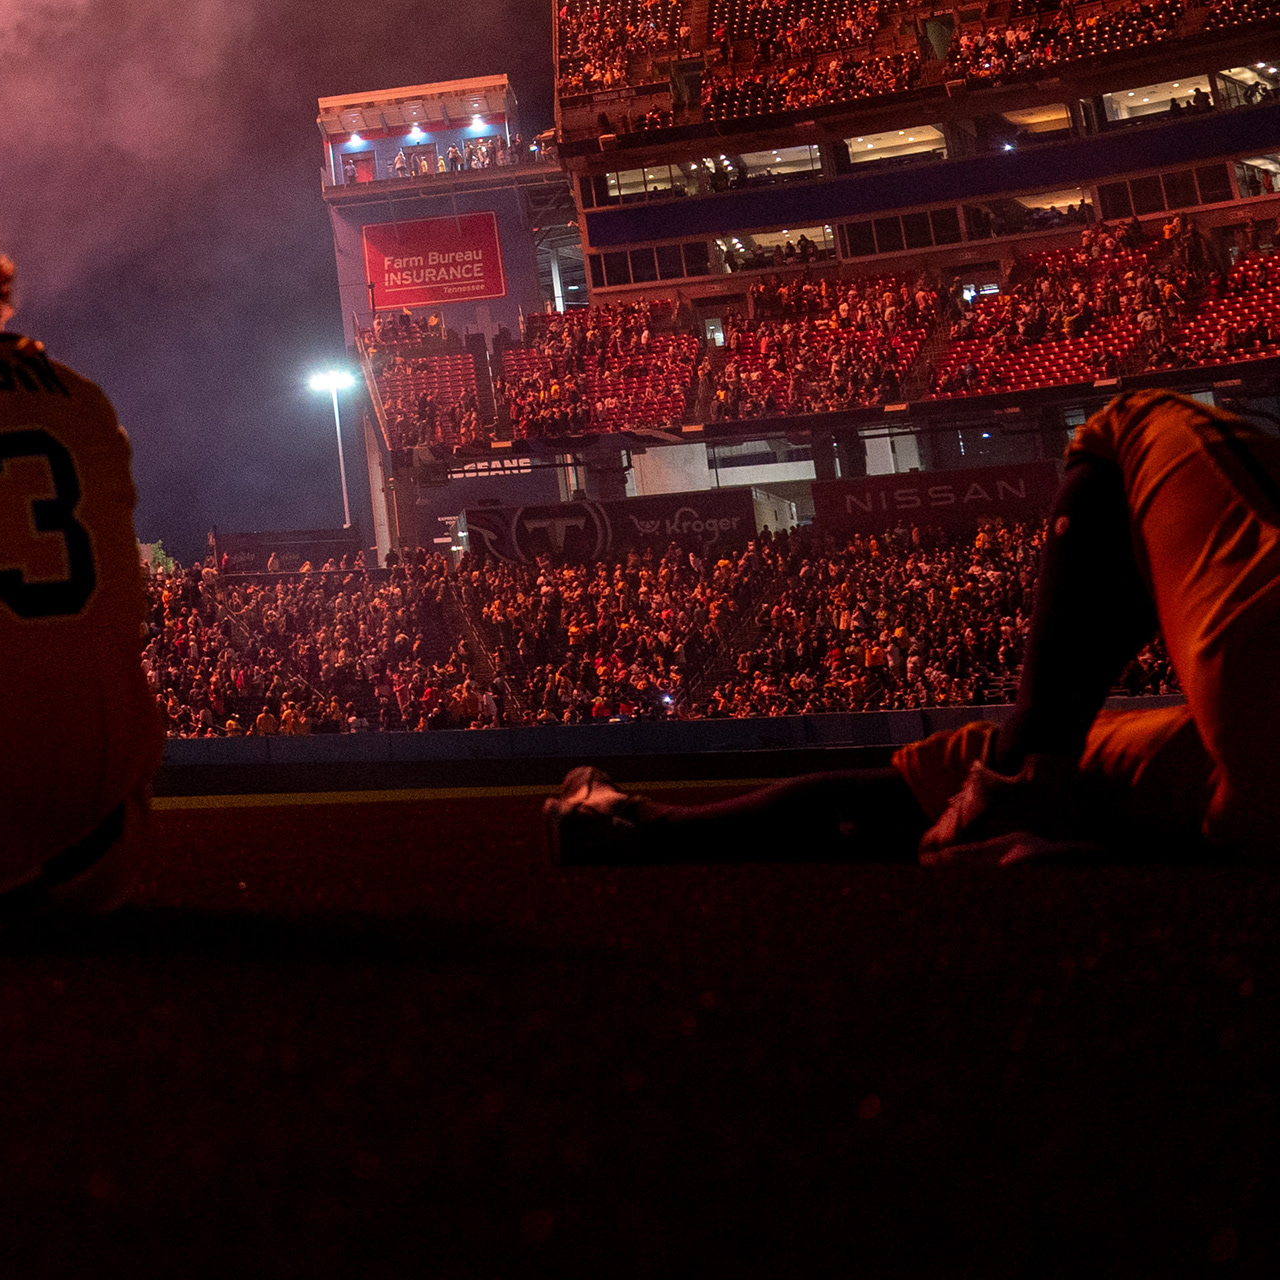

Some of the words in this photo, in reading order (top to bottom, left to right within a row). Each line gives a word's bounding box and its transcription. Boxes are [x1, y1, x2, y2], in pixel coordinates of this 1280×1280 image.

[384, 256, 424, 270] Farm
[428, 249, 483, 265] Bureau
[384, 262, 484, 287] INSURANCE
[443, 283, 486, 294] Tennessee
[843, 478, 1027, 514] NISSAN
[665, 507, 741, 545] Kroger
